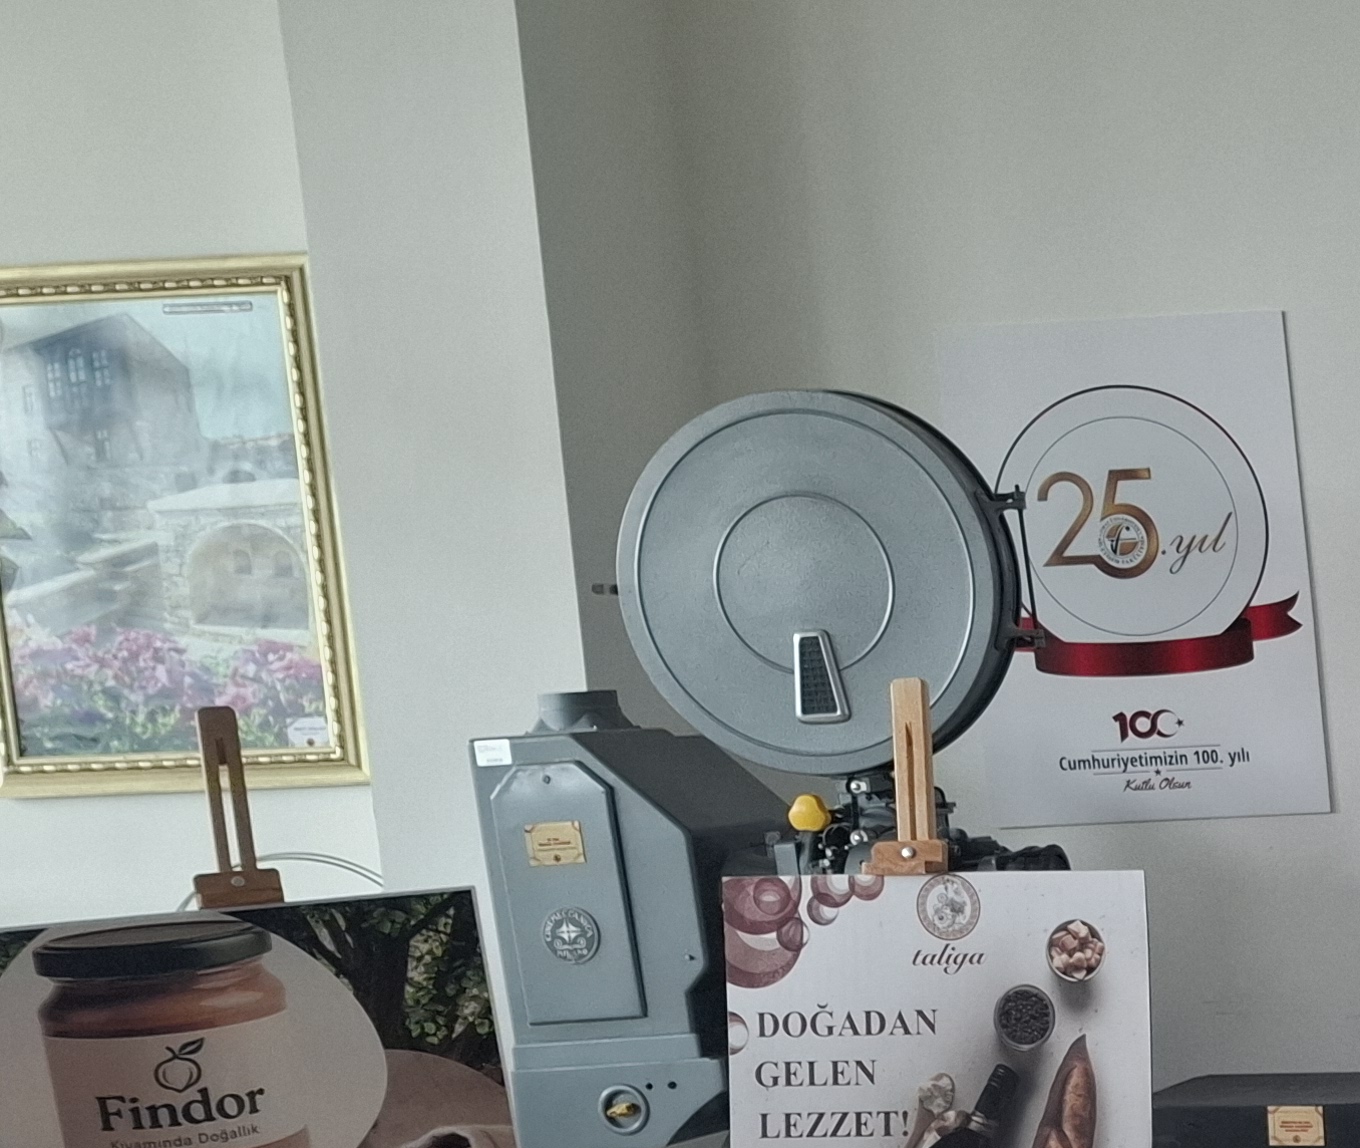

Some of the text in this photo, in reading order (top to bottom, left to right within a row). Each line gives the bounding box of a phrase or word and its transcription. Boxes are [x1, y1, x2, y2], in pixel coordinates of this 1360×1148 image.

[1059, 747, 1250, 773] Cumhuriyetimizin 100. yılı
[1123, 778, 1155, 792] Kutlu
[912, 943, 986, 975] taliga
[756, 1003, 938, 1039] DOĞADAN
[755, 1059, 877, 1089] GELEN
[95, 1087, 265, 1131] Findor
[198, 1124, 260, 1144] Doğallık
[759, 1110, 909, 1139] LEZZET!
